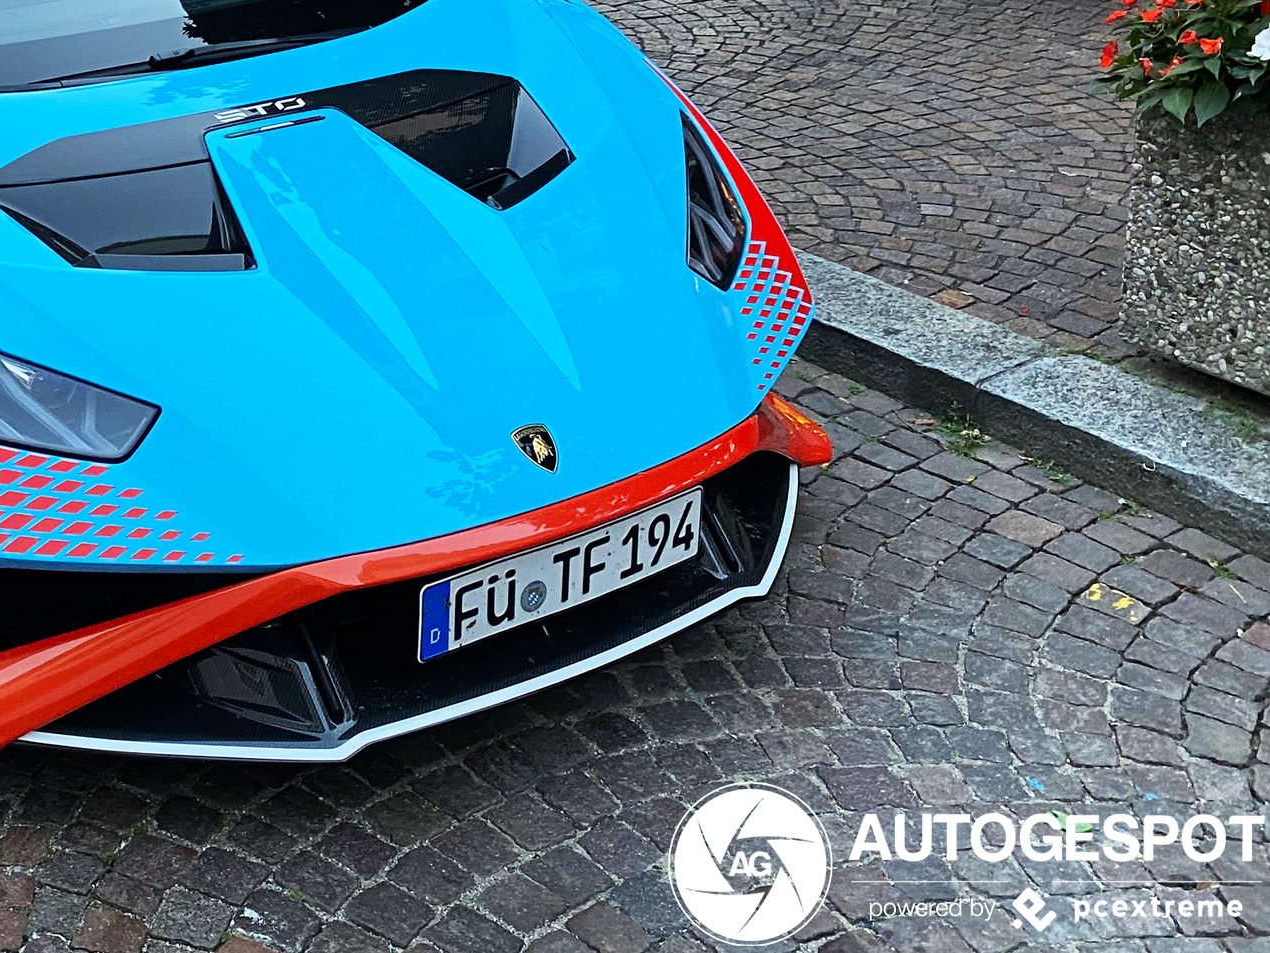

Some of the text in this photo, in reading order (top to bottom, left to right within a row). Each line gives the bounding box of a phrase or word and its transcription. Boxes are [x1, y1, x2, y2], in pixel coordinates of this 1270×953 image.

[213, 97, 307, 123] STO
[430, 627, 441, 645] D
[454, 568, 517, 642] FÜ
